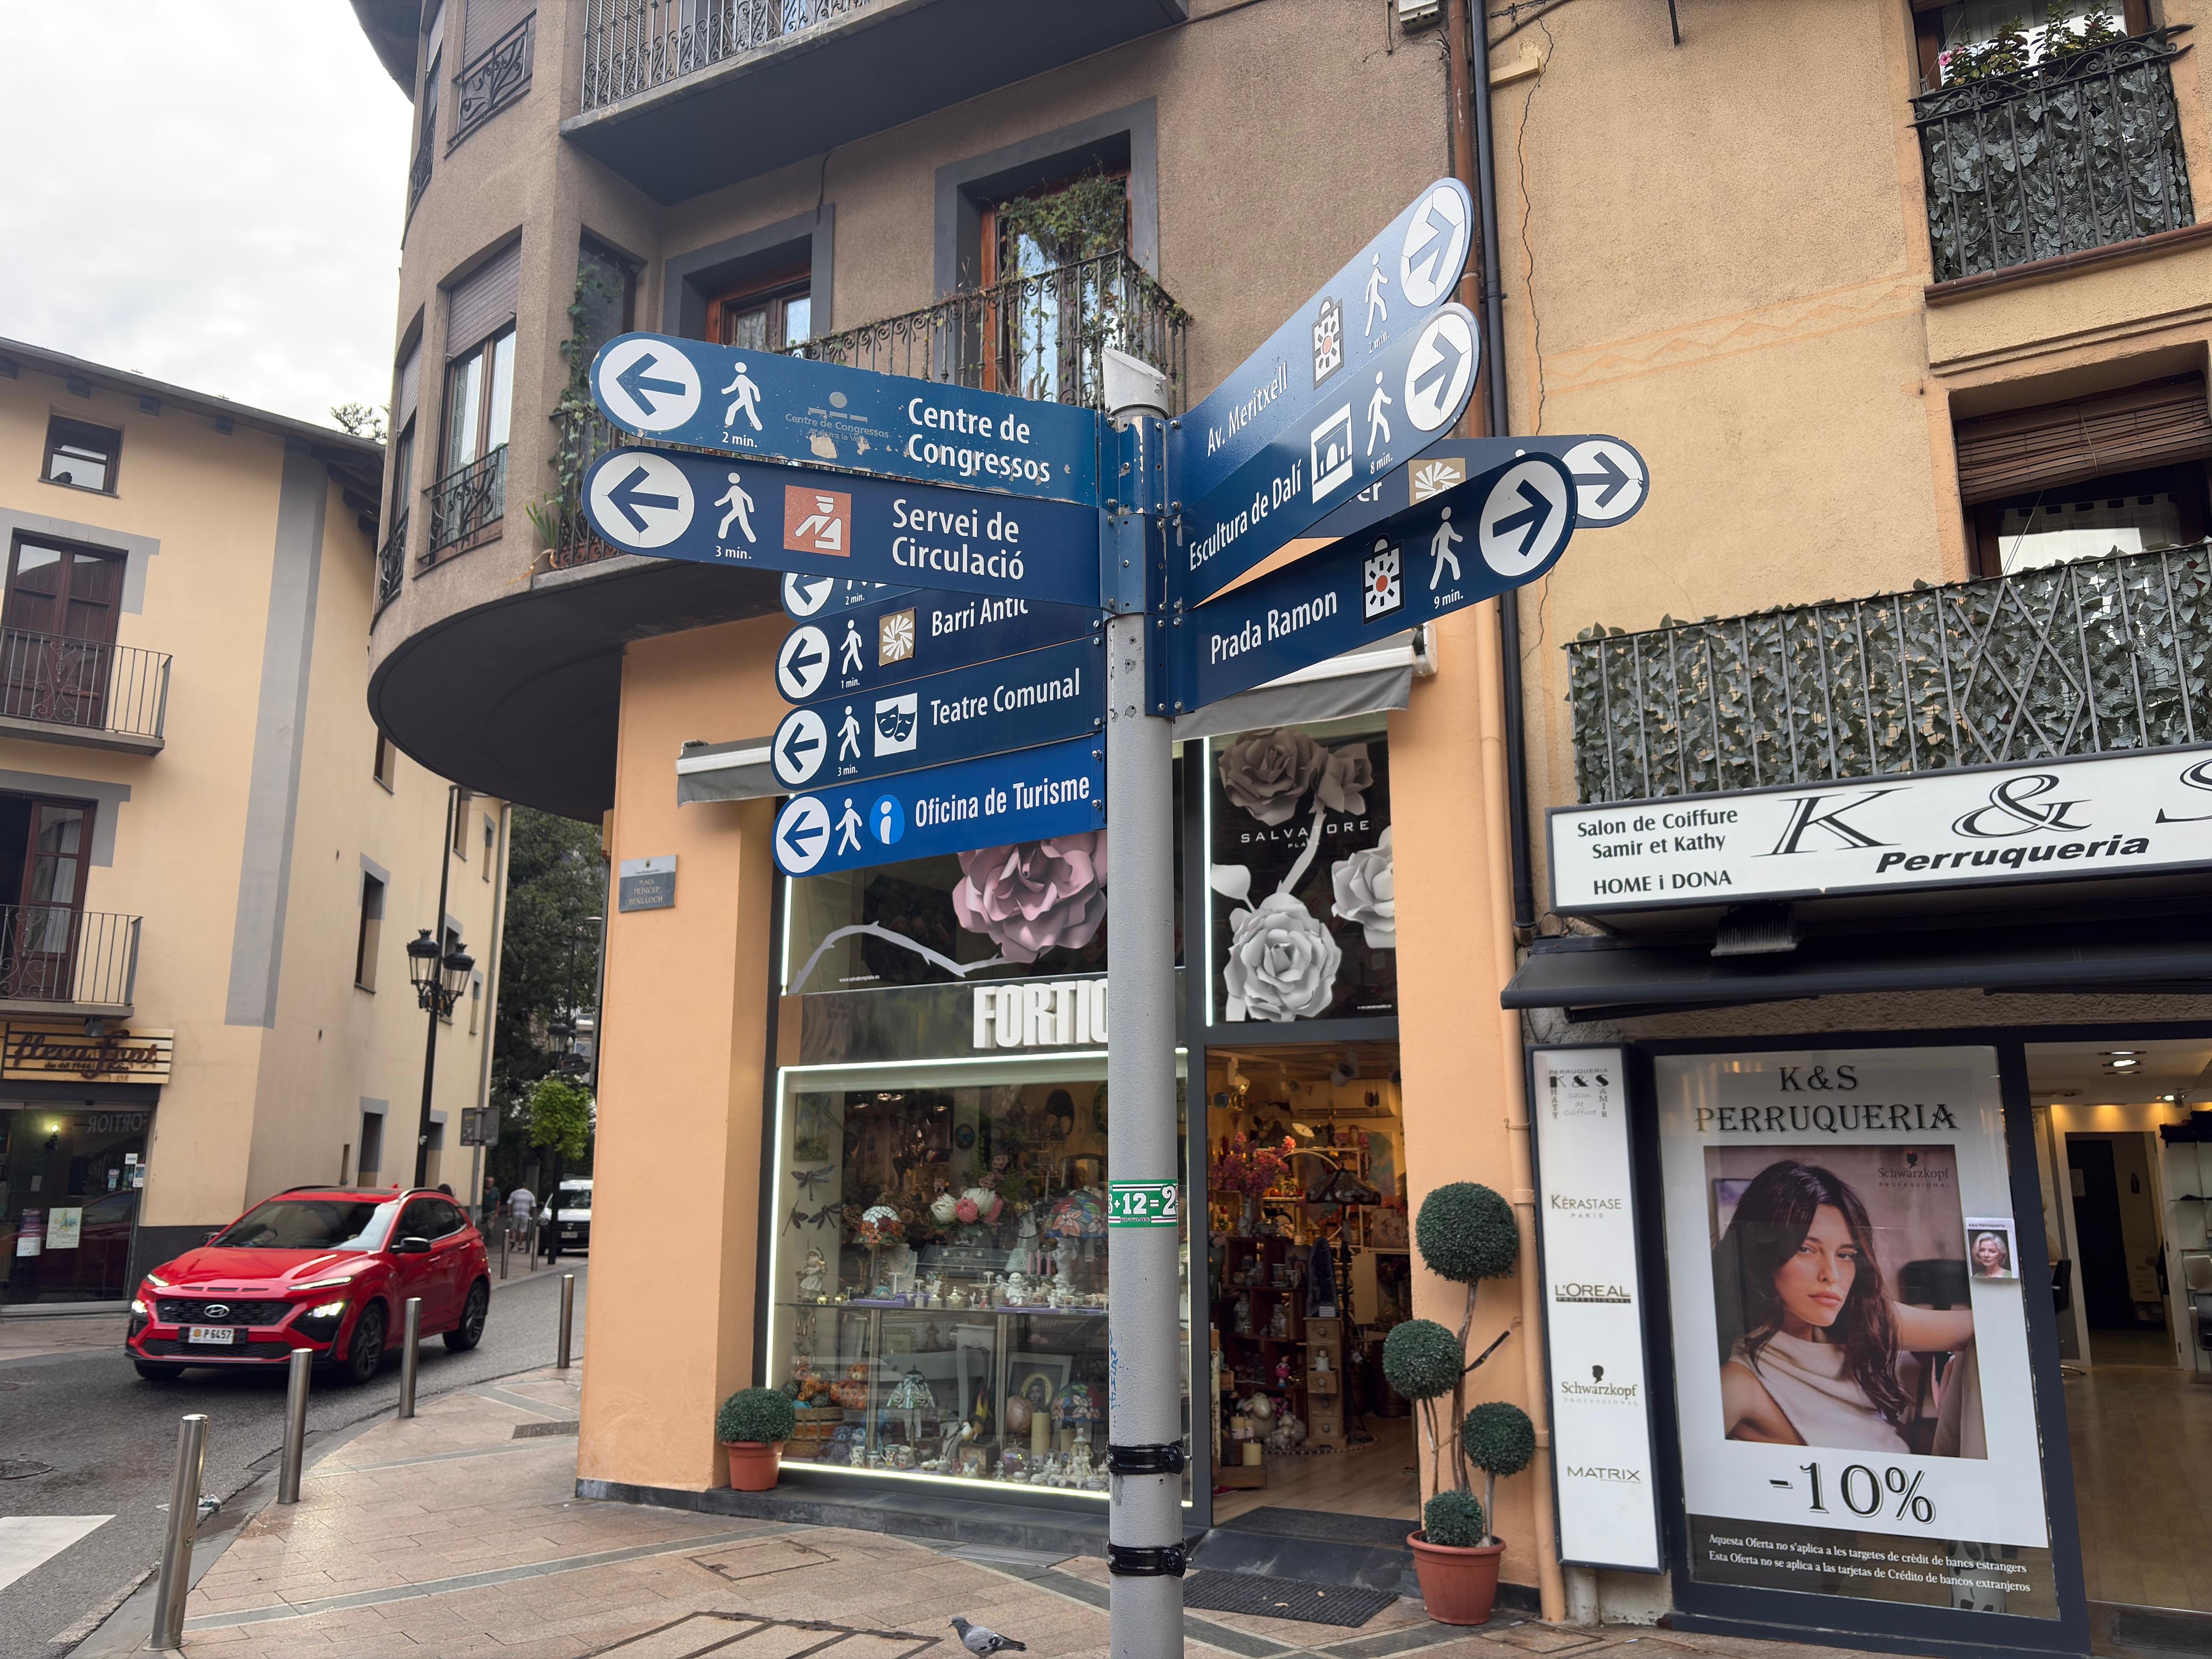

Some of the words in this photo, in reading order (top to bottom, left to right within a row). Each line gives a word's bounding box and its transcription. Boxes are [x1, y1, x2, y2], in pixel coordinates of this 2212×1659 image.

[1369, 341, 1373, 355] 2
[1375, 331, 1391, 349] min.
[908, 398, 993, 438] Centre
[1000, 414, 1030, 443] de
[1207, 425, 1226, 457] Av.
[1228, 361, 1288, 439] Meritxell
[785, 413, 817, 426] Centre
[820, 419, 832, 428] de
[835, 422, 889, 438] Congressos
[722, 431, 729, 443] 2
[732, 435, 758, 448] min.
[850, 434, 868, 444] Vea
[908, 433, 1051, 482] Congressos
[1370, 461, 1375, 474] 8
[1377, 452, 1393, 471] min.
[893, 499, 978, 538] Servei
[987, 511, 1019, 543] de
[1189, 508, 1248, 572] Escultura
[1251, 493, 1269, 525] de
[1272, 458, 1303, 510] Dalí
[716, 546, 722, 557] 3
[725, 548, 752, 560] min.
[892, 536, 1025, 580] Circulació
[845, 597, 850, 605] 2
[851, 593, 865, 604] min.
[1434, 597, 1439, 609] 9
[1442, 590, 1464, 608] min.
[932, 601, 975, 637] Barri
[979, 598, 1028, 625] Antic
[1211, 619, 1263, 665] Prada
[1268, 591, 1337, 643] Ramon
[841, 680, 844, 689] 1
[845, 677, 860, 689] min.
[931, 696, 987, 726] Teatre
[993, 668, 1080, 711] Comunal
[838, 767, 842, 776] 3
[843, 765, 858, 776] min.
[915, 795, 979, 827] Oficina
[985, 787, 1007, 815] de
[1013, 776, 1090, 810] Turisme
[1577, 817, 1626, 837] Salon
[1633, 816, 1656, 832] de
[1663, 809, 1738, 829] Coiffure
[1750, 786, 1914, 858] K
[1951, 774, 2092, 838] &
[1241, 820, 1370, 843] SALVATORE
[1593, 840, 1643, 859] Samir
[1649, 839, 1667, 854] et
[1674, 833, 1725, 852] Kathy
[1875, 834, 2150, 874] Perruqueria
[1593, 876, 1652, 895] HOME
[1659, 875, 1664, 890] i
[1672, 870, 1732, 890] DONA
[630, 896, 663, 905] BENLLOCH
[1572, 1075, 1589, 1088] &
[1595, 1074, 1608, 1087] S
[1779, 1065, 1859, 1092] K&S
[1696, 1103, 1961, 1135] PERRUQUERIA
[1878, 1168, 1950, 1180] Schwarzkopf
[204, 1329, 209, 1338] P
[211, 1329, 231, 1339] 6457
[1561, 1381, 1638, 1400] Schwarzkopf
[1567, 1465, 1641, 1481] MATRIX
[1769, 1462, 1937, 1524] -10%
[1709, 1534, 1744, 1546] Aquesta
[1746, 1537, 1774, 1549] Oferta
[1790, 1543, 1824, 1555] s'aplica
[1833, 1546, 1847, 1556] les
[1849, 1548, 1885, 1561] targetes
[1888, 1551, 1899, 1561] de
[1901, 1553, 1929, 1564] crèdit
[1932, 1555, 1943, 1566] de
[1946, 1557, 1974, 1568] bancs
[1976, 1561, 2027, 1574] estrangers
[1709, 1551, 1728, 1562] Esta
[1730, 1553, 1758, 1565] Oferta
[1786, 1559, 1813, 1571] aplica
[1823, 1562, 1836, 1573] las
[1838, 1565, 1872, 1577] tarjetas
[1874, 1568, 1886, 1578] de
[1888, 1568, 1923, 1582] Crédito
[1926, 1572, 1938, 1583] de
[1940, 1573, 1974, 1586] bancos
[1976, 1579, 2031, 1593] extranjeros
